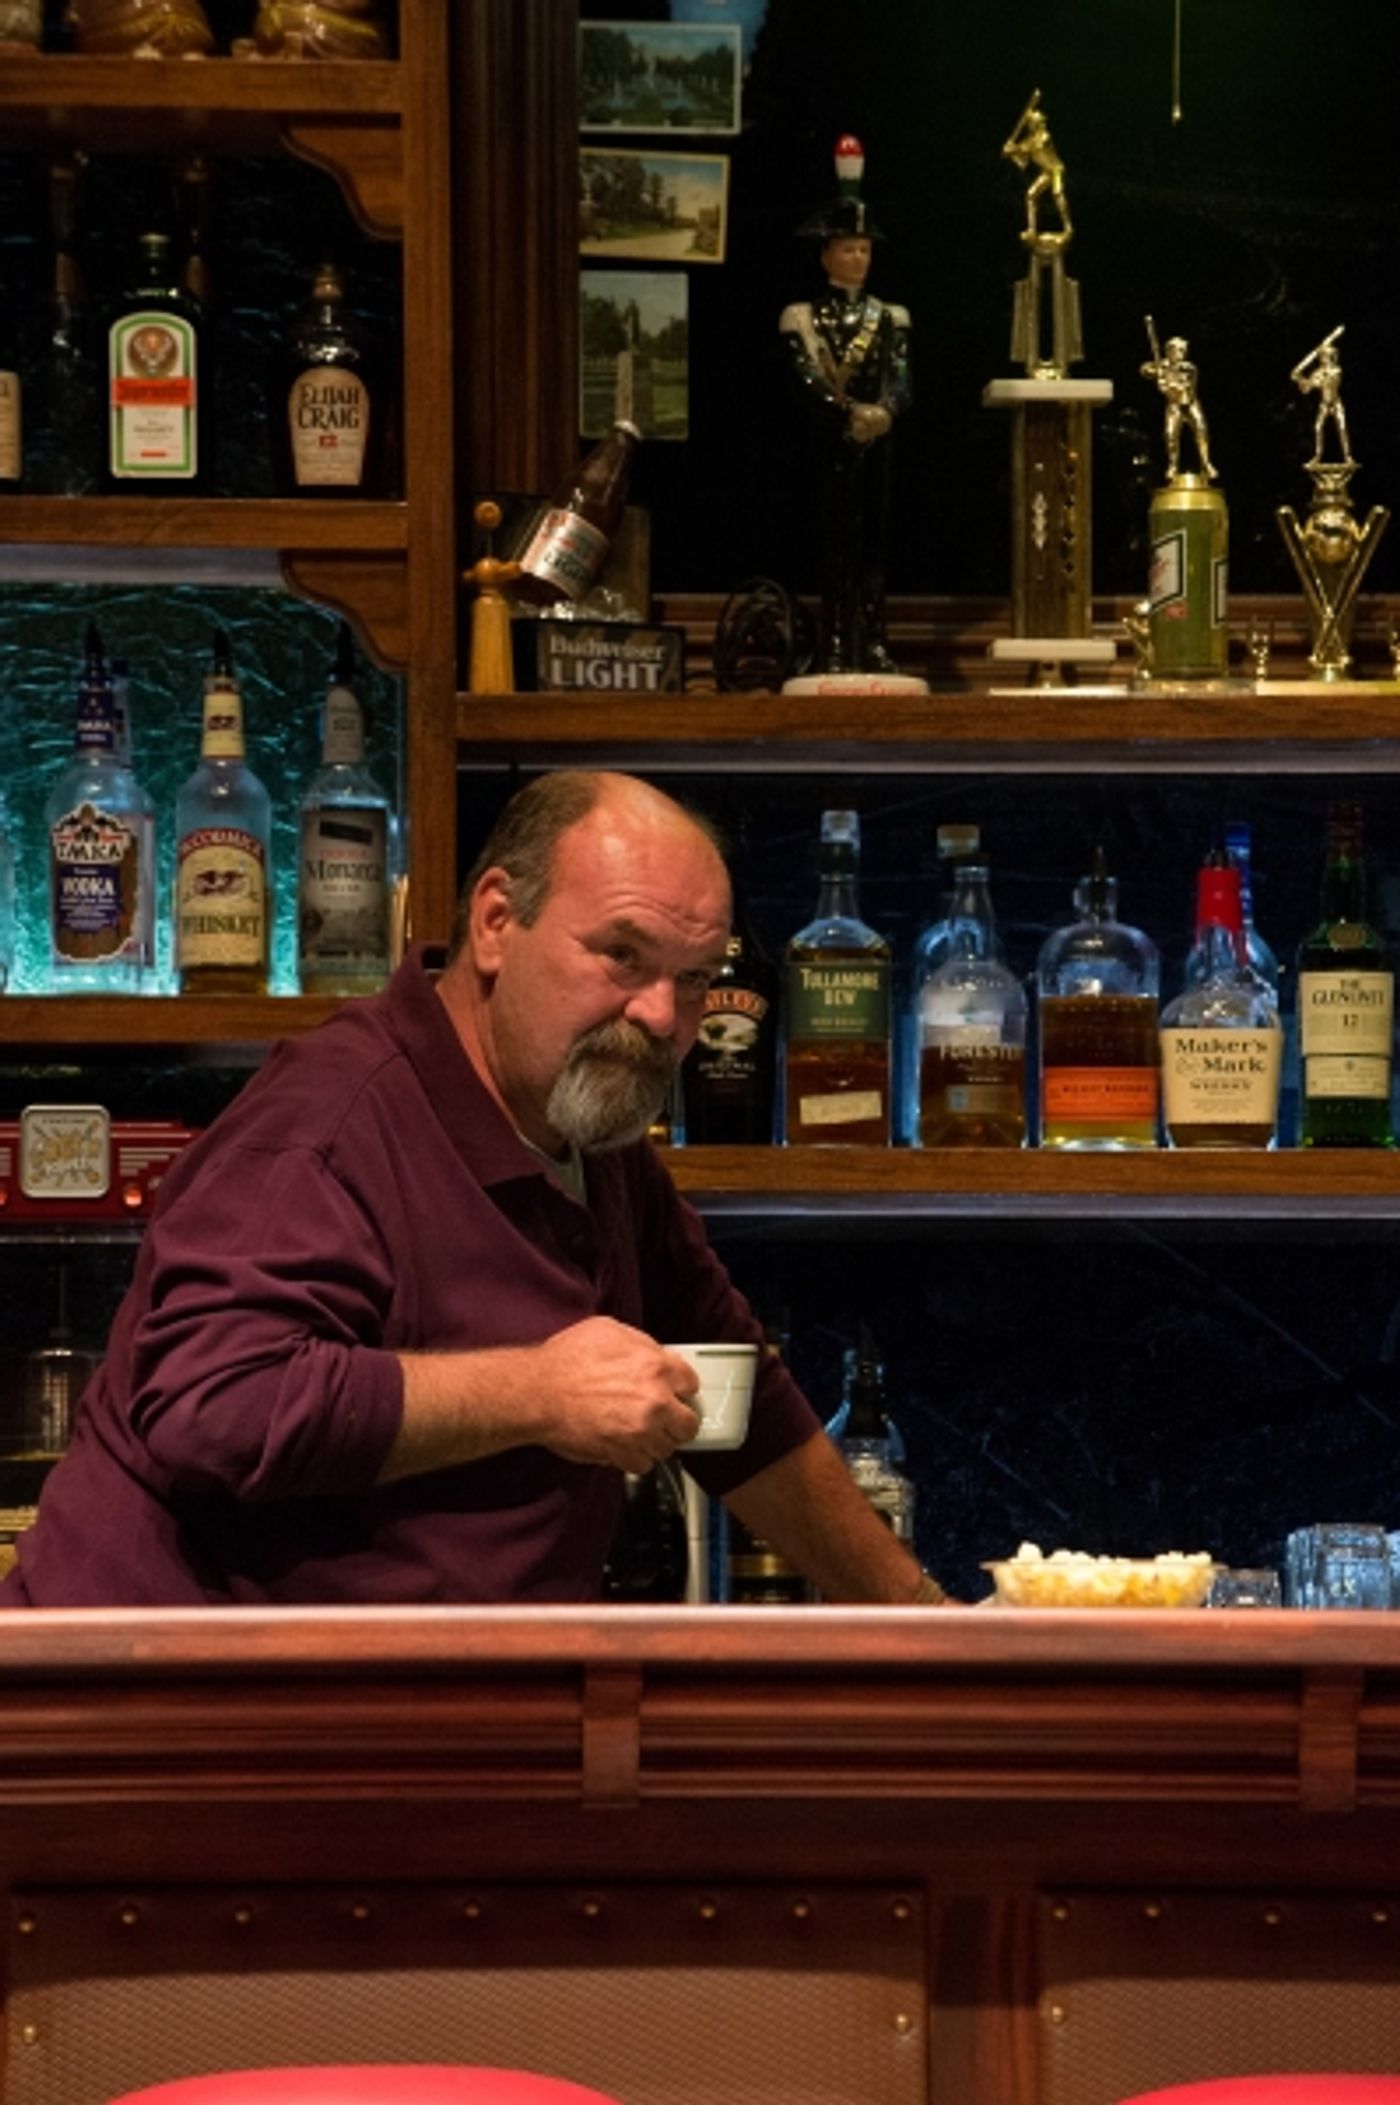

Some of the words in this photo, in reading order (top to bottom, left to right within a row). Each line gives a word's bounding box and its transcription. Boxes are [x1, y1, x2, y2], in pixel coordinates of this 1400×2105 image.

[300, 383, 360, 407] ELIJAH
[297, 405, 360, 431] CRAIG
[550, 634, 666, 661] Budweiser
[551, 659, 665, 690] LIGHT
[61, 876, 116, 897] VODKA
[800, 967, 880, 991] TULLAMORE
[1175, 1038, 1267, 1054] Maker's
[1202, 1056, 1267, 1074] Mark
